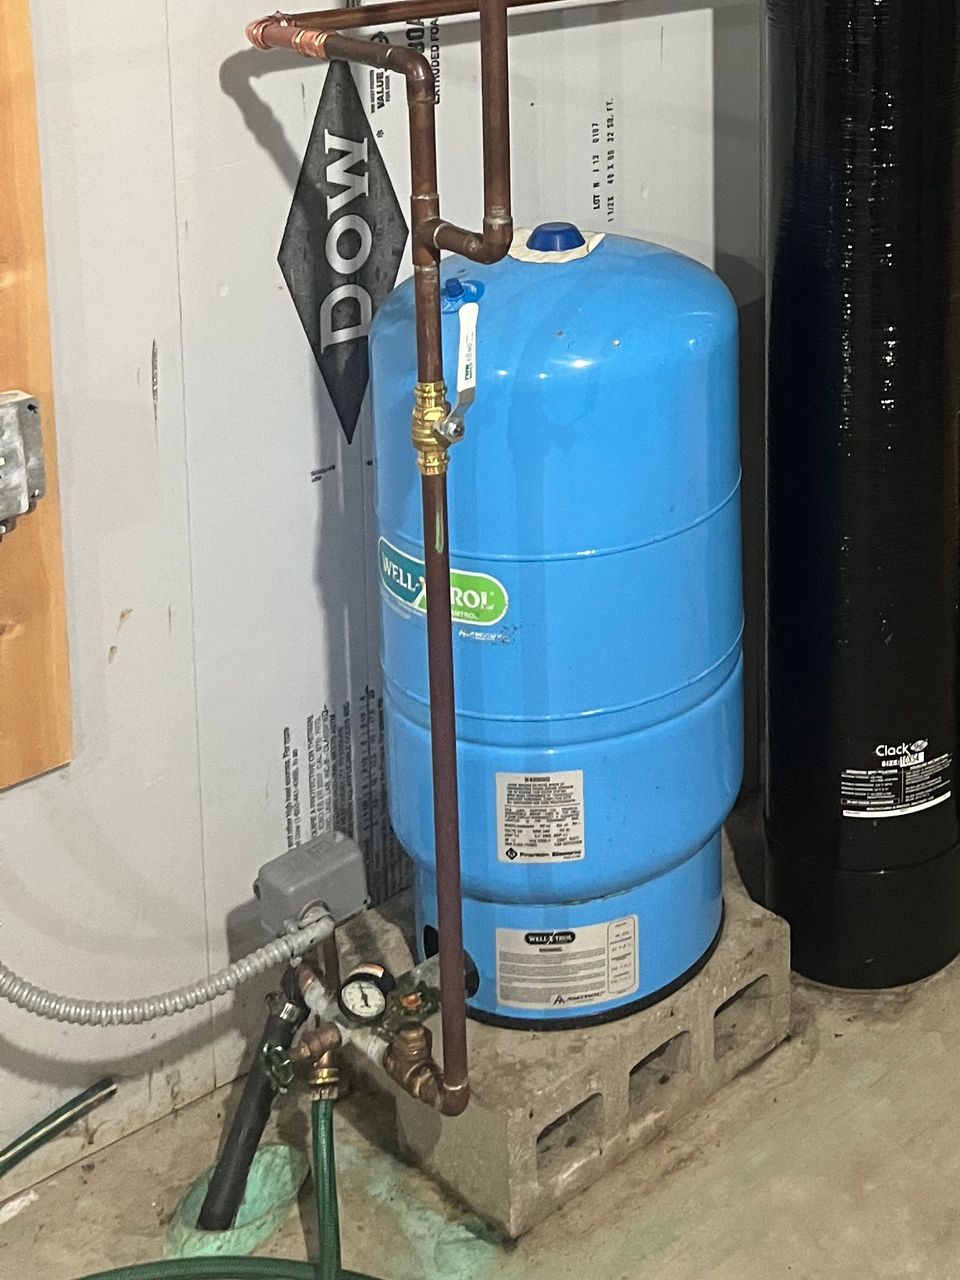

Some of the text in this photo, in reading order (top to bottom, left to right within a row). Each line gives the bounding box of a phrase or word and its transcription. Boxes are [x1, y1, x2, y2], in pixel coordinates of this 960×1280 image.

[428, 17, 439, 42] FOA
[376, 72, 384, 110] VALUE
[320, 128, 373, 353] DOW
[381, 552, 495, 610] WELL ROL
[876, 742, 909, 756] Clack
